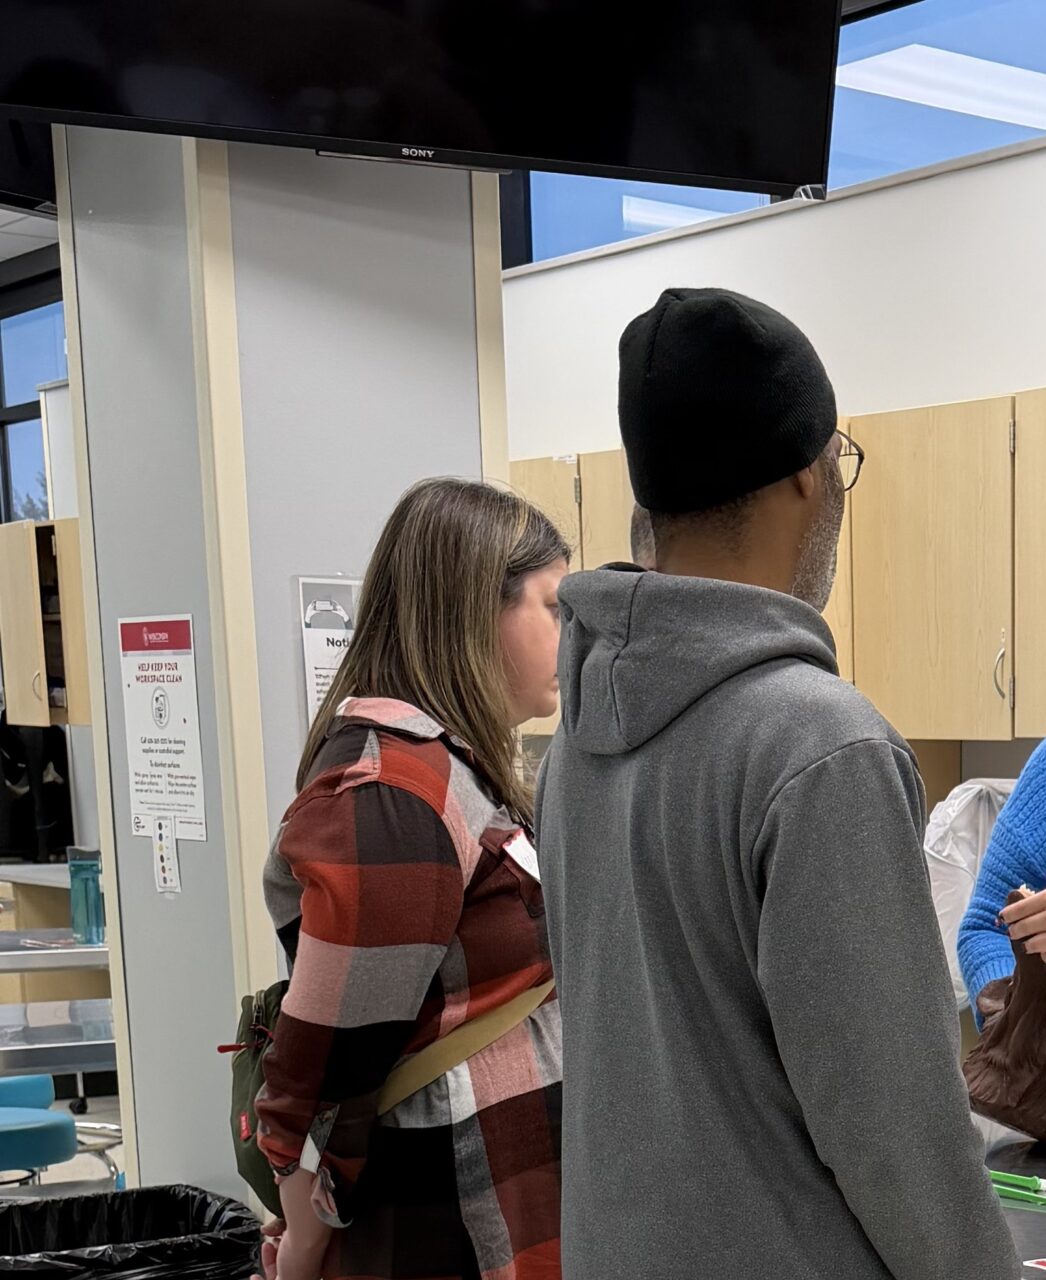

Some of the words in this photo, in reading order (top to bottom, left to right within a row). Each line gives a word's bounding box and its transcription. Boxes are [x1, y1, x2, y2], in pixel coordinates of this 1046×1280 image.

[402, 147, 435, 158] SONY
[138, 663, 150, 672] HELP
[151, 663, 163, 672] KEEP
[135, 674, 165, 683] WORKSPACE
[166, 674, 183, 682] CLEAN
